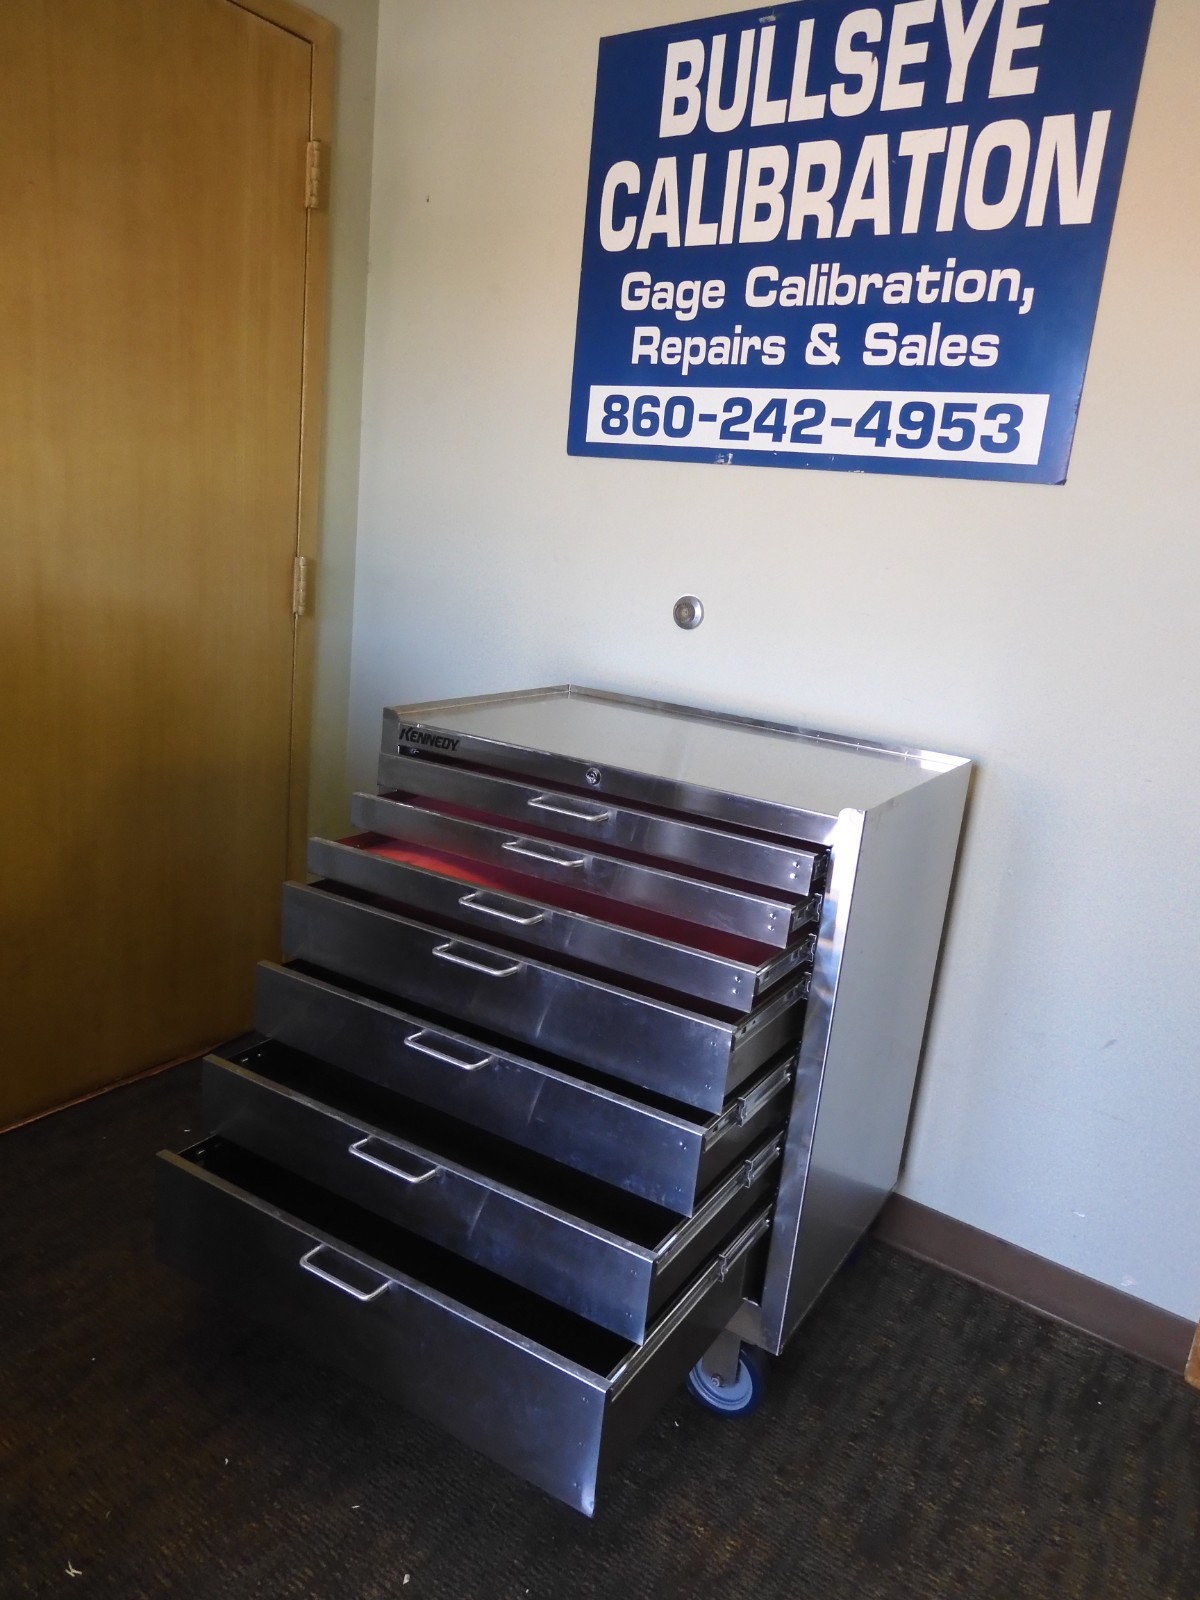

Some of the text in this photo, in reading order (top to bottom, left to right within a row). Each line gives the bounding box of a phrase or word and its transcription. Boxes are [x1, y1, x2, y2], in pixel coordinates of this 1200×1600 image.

[659, 0, 1048, 138] BULLSEYE
[599, 110, 1112, 253] CALIBRATION
[621, 258, 1035, 321] Gage Calibration,
[631, 322, 1000, 376] Repairs & Sales
[601, 394, 1025, 454] 860-242-4953
[399, 726, 461, 752] KENNEDY
